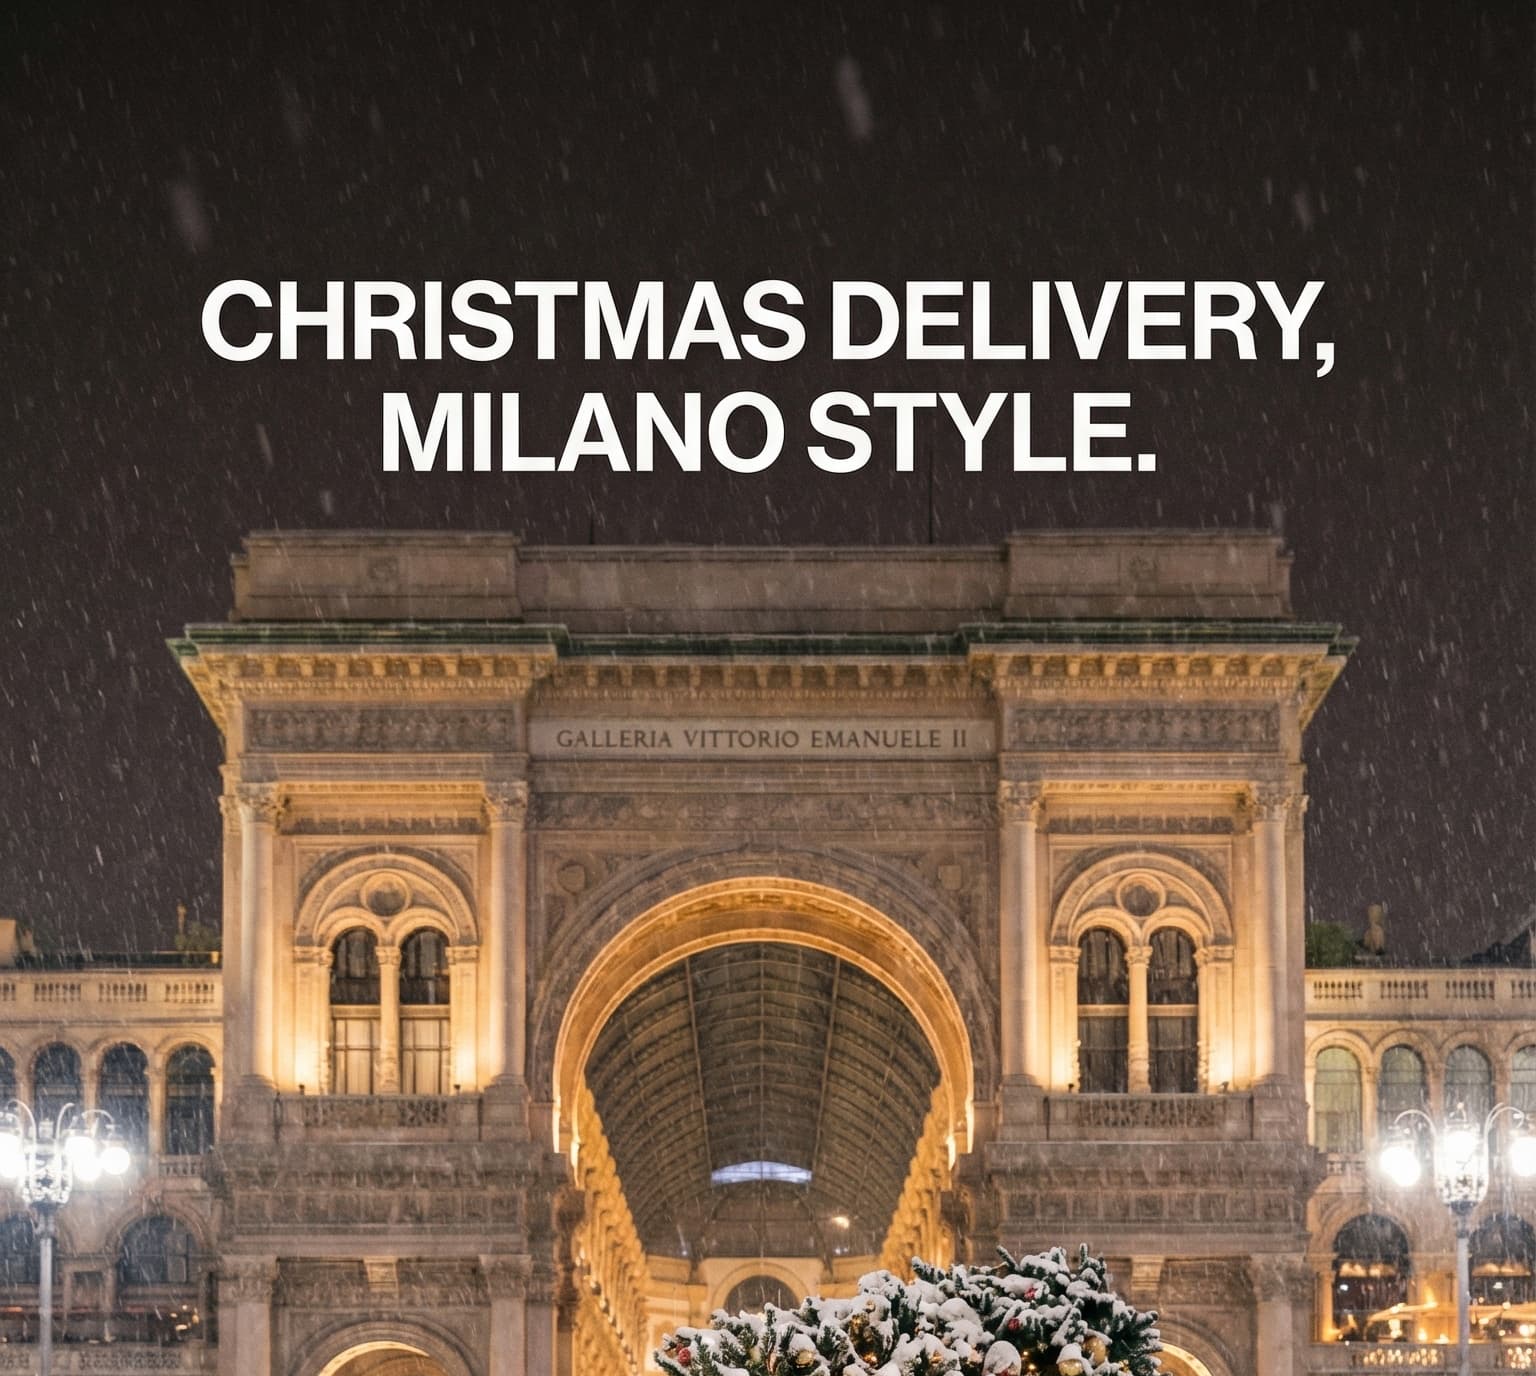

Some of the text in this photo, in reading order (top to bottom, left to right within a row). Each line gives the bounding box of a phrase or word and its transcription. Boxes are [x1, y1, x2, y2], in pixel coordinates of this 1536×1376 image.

[556, 728, 967, 749] GALLERIA VITTORIO EMANUELE II
